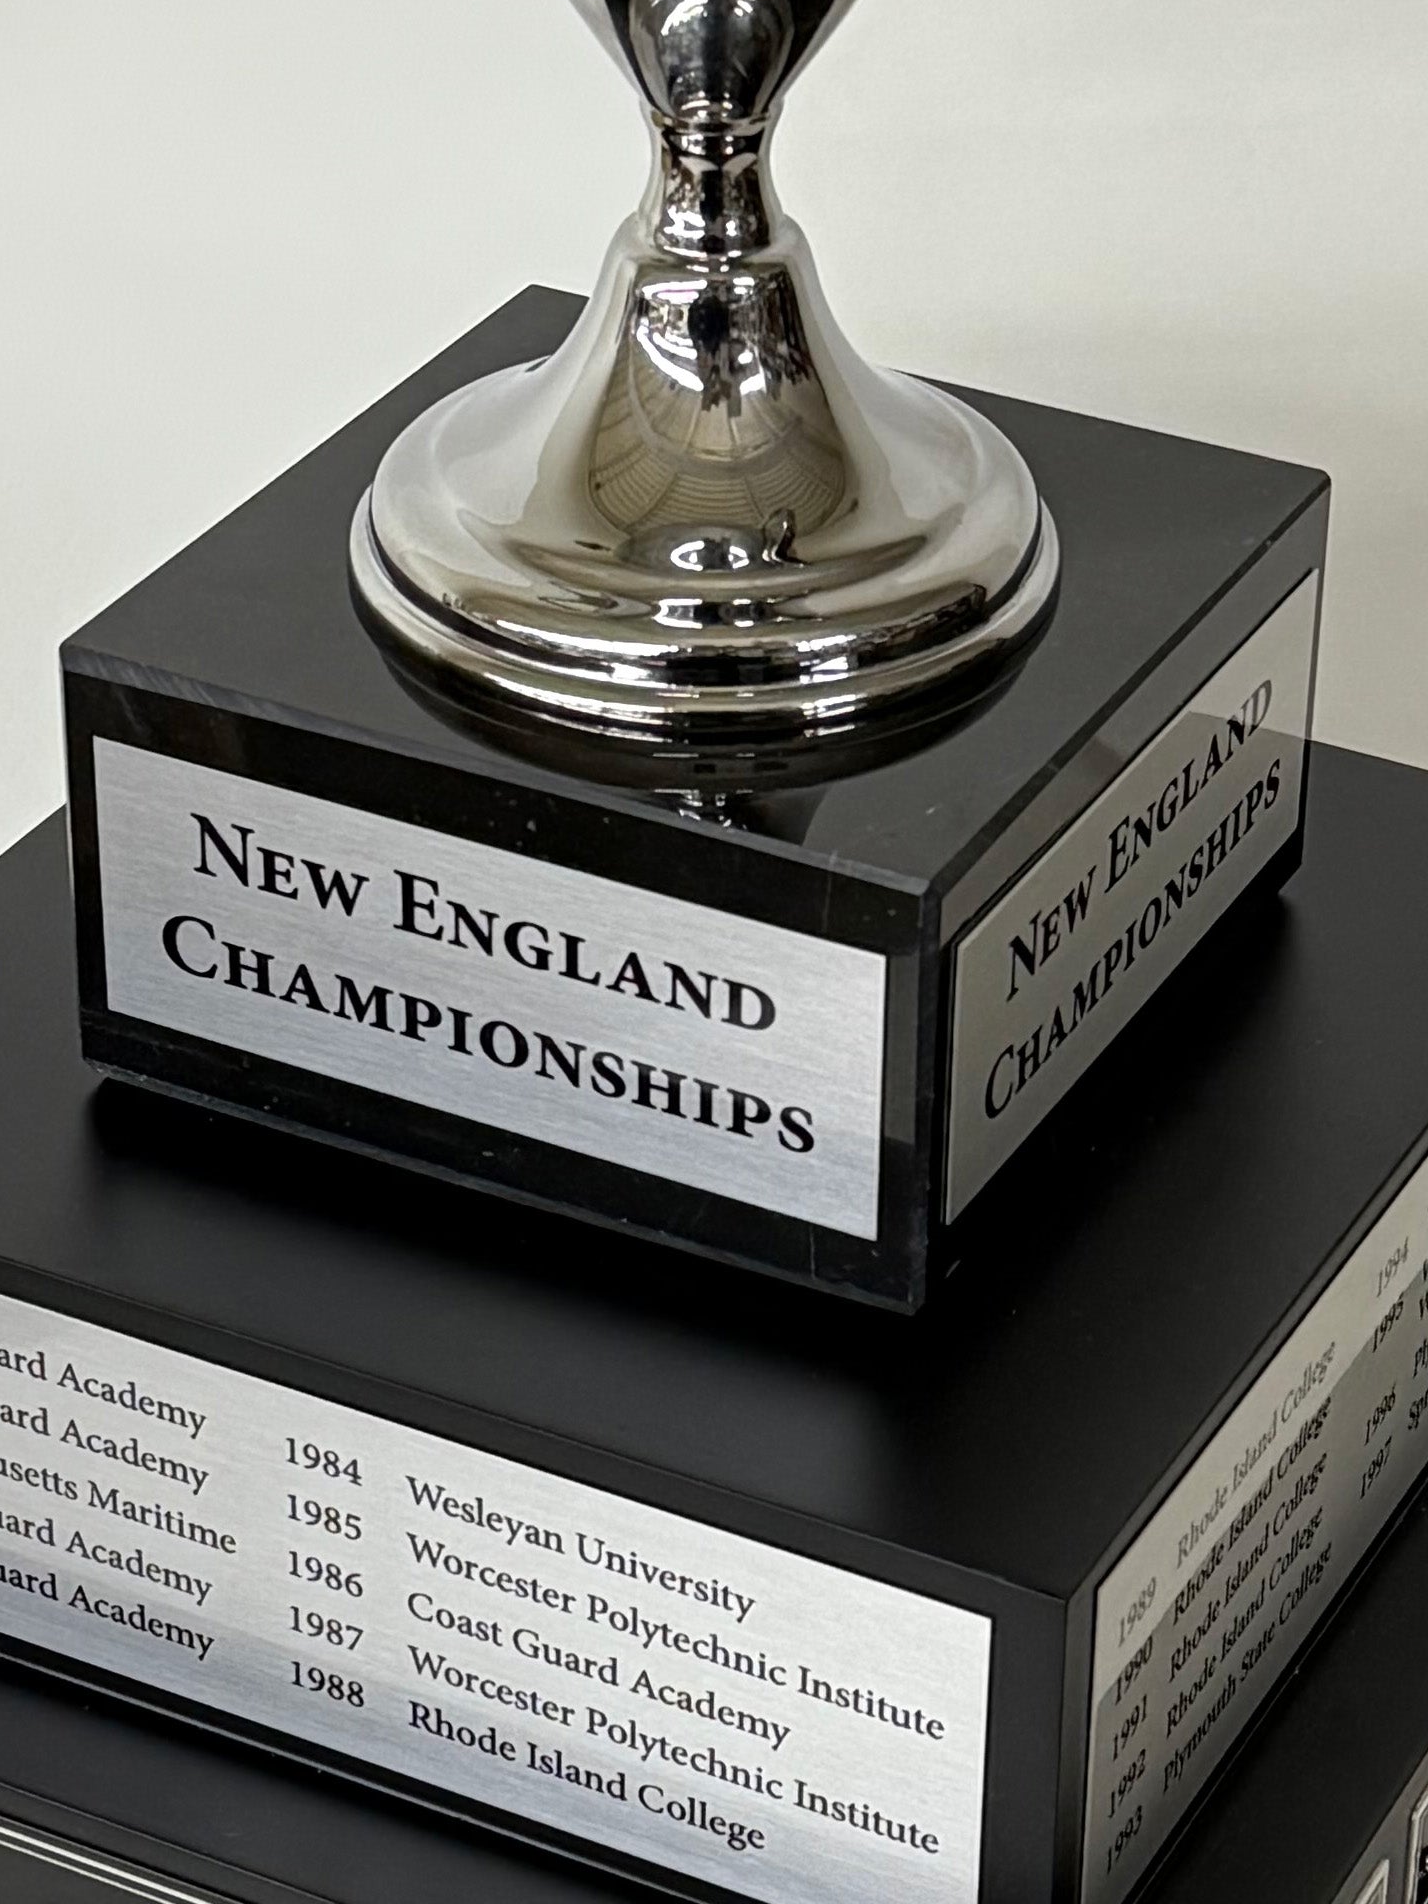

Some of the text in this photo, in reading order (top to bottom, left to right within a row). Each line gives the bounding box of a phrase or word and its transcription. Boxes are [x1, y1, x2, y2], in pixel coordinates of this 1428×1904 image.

[55, 1361, 208, 1440] Academy
[58, 1417, 210, 1496] Academy
[1116, 1339, 1336, 1648] 1989 Rhode Island College
[63, 1529, 213, 1607] Academy
[86, 1478, 237, 1555] Maritime
[284, 1436, 757, 1624] 1984 Wesleyan University
[285, 1492, 945, 1741] 1985 Worcester Polytechnic Institute
[1111, 1451, 1328, 1763] 1991 Rhode Island College
[1113, 1394, 1332, 1706] 1990 Rhode Island College
[65, 1583, 215, 1662] Academy
[287, 1549, 792, 1752] 1986 Coast Guard Academy
[1105, 1540, 1333, 1875] 1993 Plymouth State College
[1106, 1504, 1323, 1820] 1992 Rhode Island College
[288, 1604, 939, 1855] 1987 Worcester Polytechnic Institute
[289, 1659, 765, 1852] 1988 Rhode Island College
